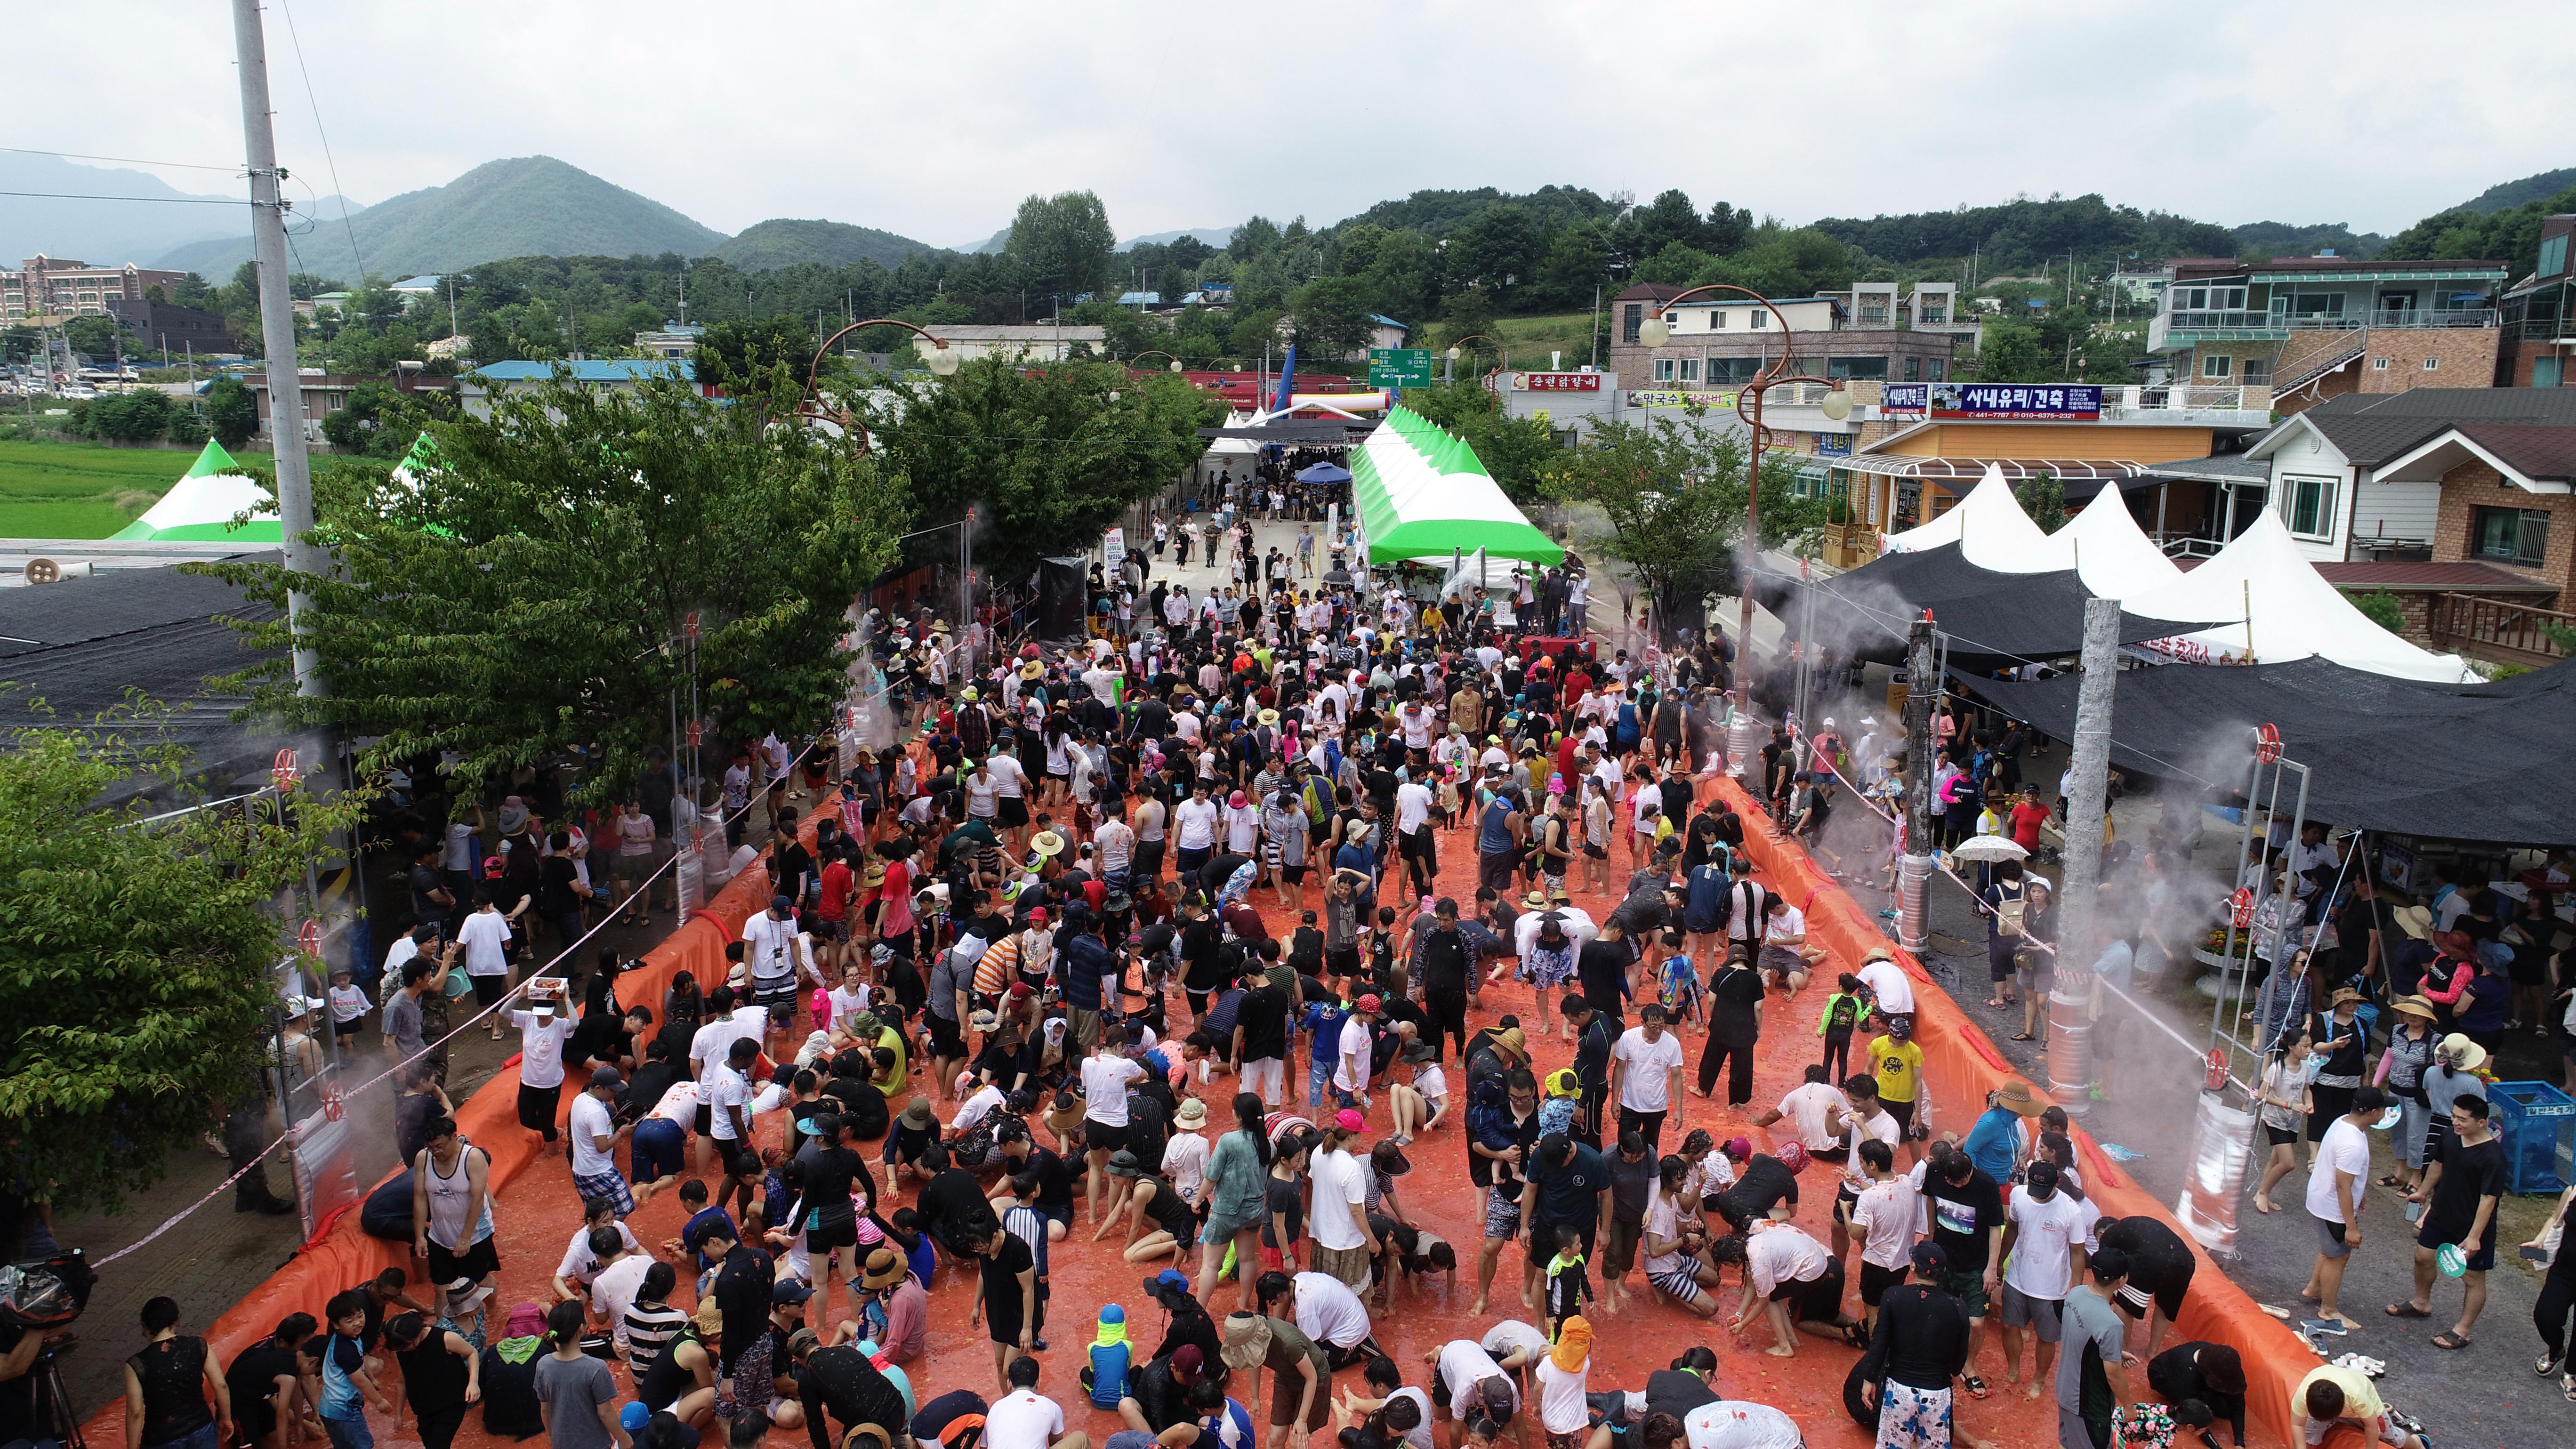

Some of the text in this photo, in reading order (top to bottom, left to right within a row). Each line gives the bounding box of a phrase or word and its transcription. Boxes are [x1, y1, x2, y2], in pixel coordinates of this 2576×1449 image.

[1643, 393, 1680, 406] 막국수
[1889, 388, 1916, 405] 사내유리/건축
[1966, 388, 2063, 409] 사내유리/건축
[1098, 755, 1103, 763] P
[2530, 1106, 2573, 1115] 일반쓰레기
